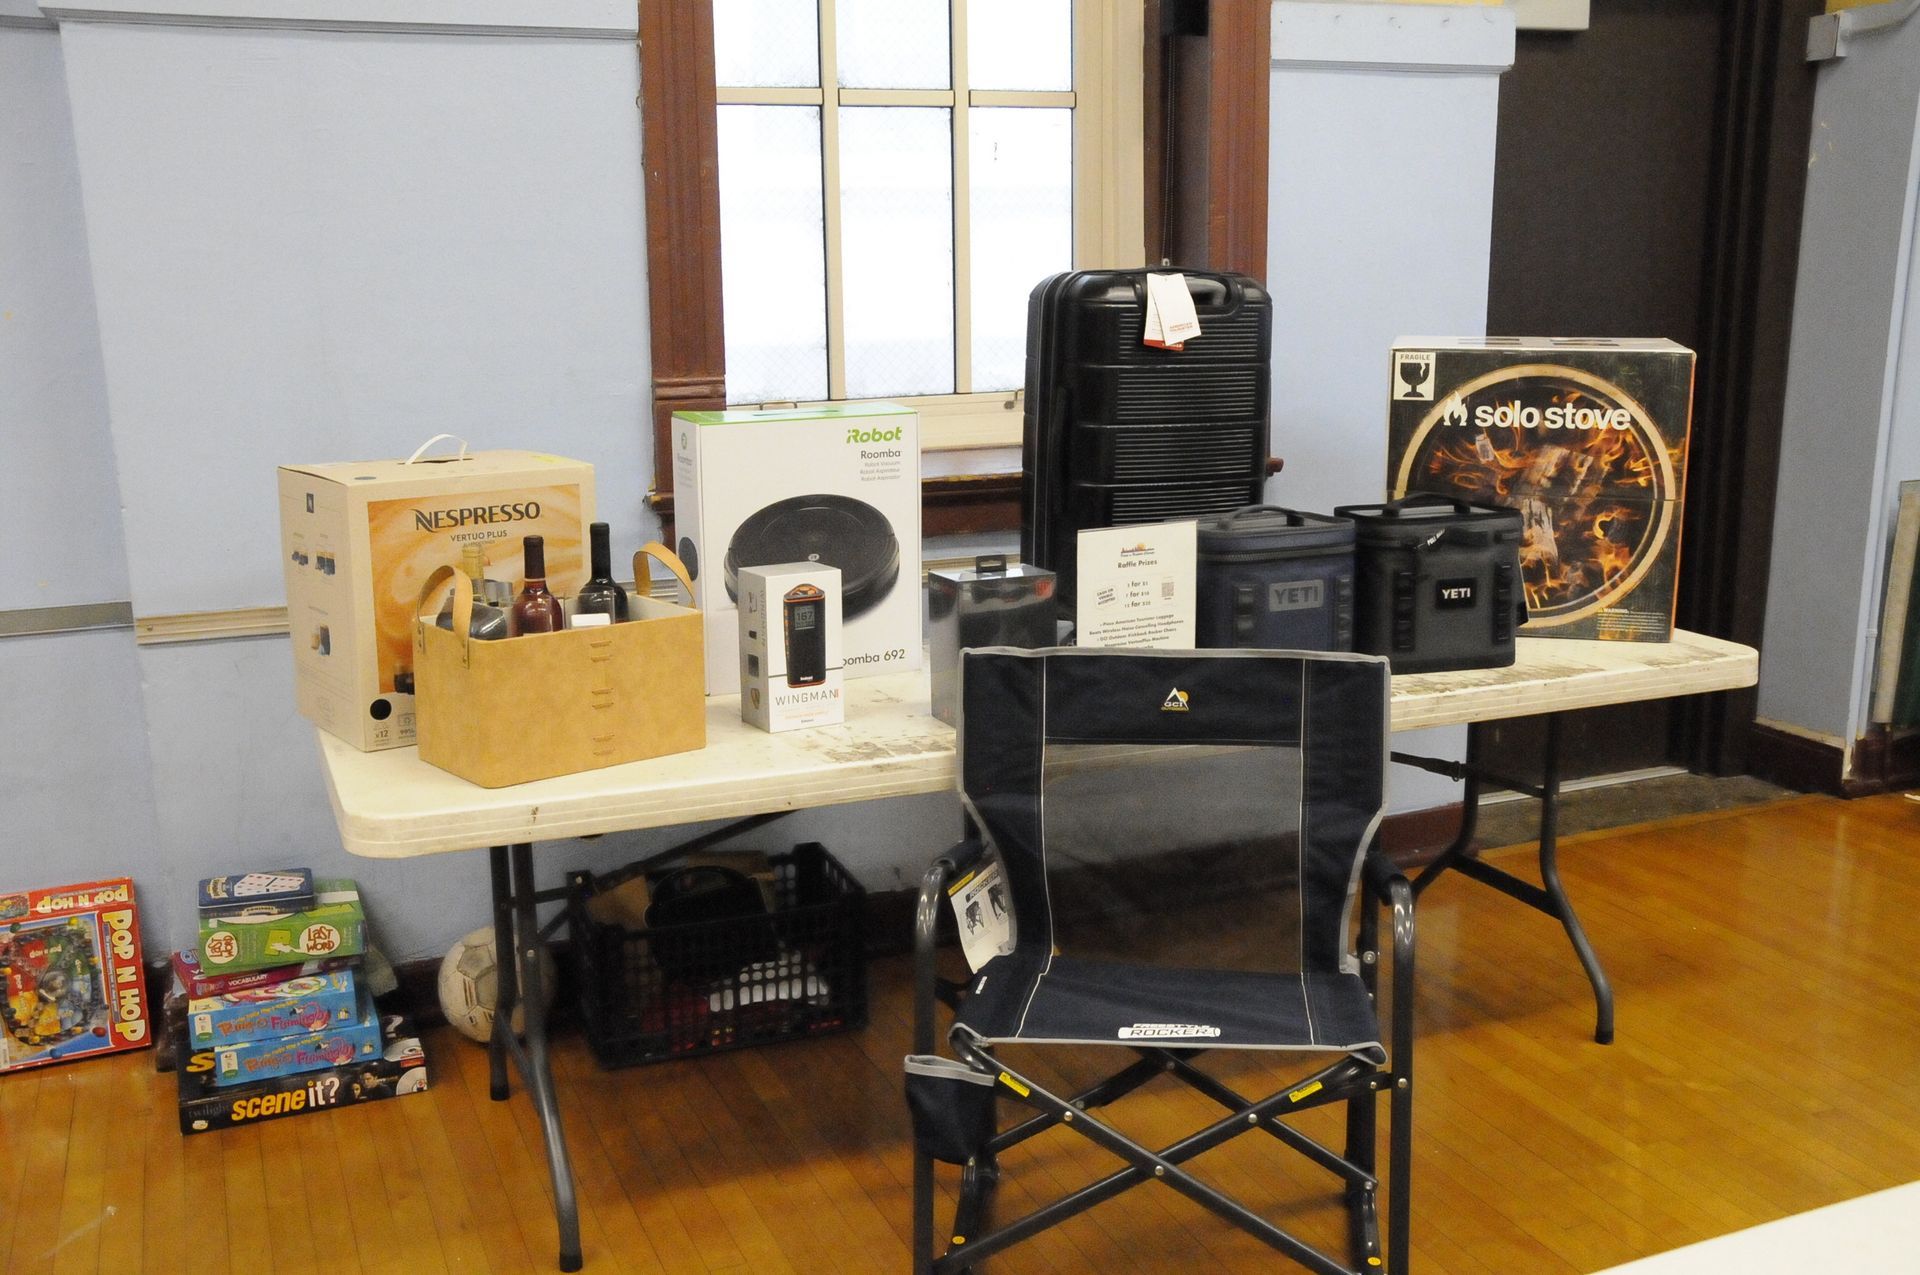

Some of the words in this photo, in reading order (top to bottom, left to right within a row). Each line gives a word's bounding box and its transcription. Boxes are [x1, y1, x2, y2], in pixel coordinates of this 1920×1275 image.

[1474, 400, 1540, 428] solo
[1544, 402, 1631, 430] stove
[846, 426, 902, 444] iRobot
[860, 448, 901, 460] Roomba
[410, 502, 540, 533] NESPRESSO
[450, 532, 485, 542] VERTUO
[486, 530, 508, 539] PLUS
[1273, 585, 1319, 605] YETI
[1442, 588, 1472, 600] YETI
[884, 648, 905, 662] 692
[776, 690, 836, 706] WINGMAN
[78, 894, 90, 906] N
[94, 884, 128, 904] POP
[36, 895, 74, 914] HOP
[102, 909, 134, 960] POP
[116, 966, 137, 984] N
[228, 974, 268, 986] VOCABULARY
[115, 988, 146, 1042] HOP
[1130, 1028, 1208, 1036] ROCKER
[231, 1090, 306, 1122] scene
[308, 1076, 341, 1108] it?
